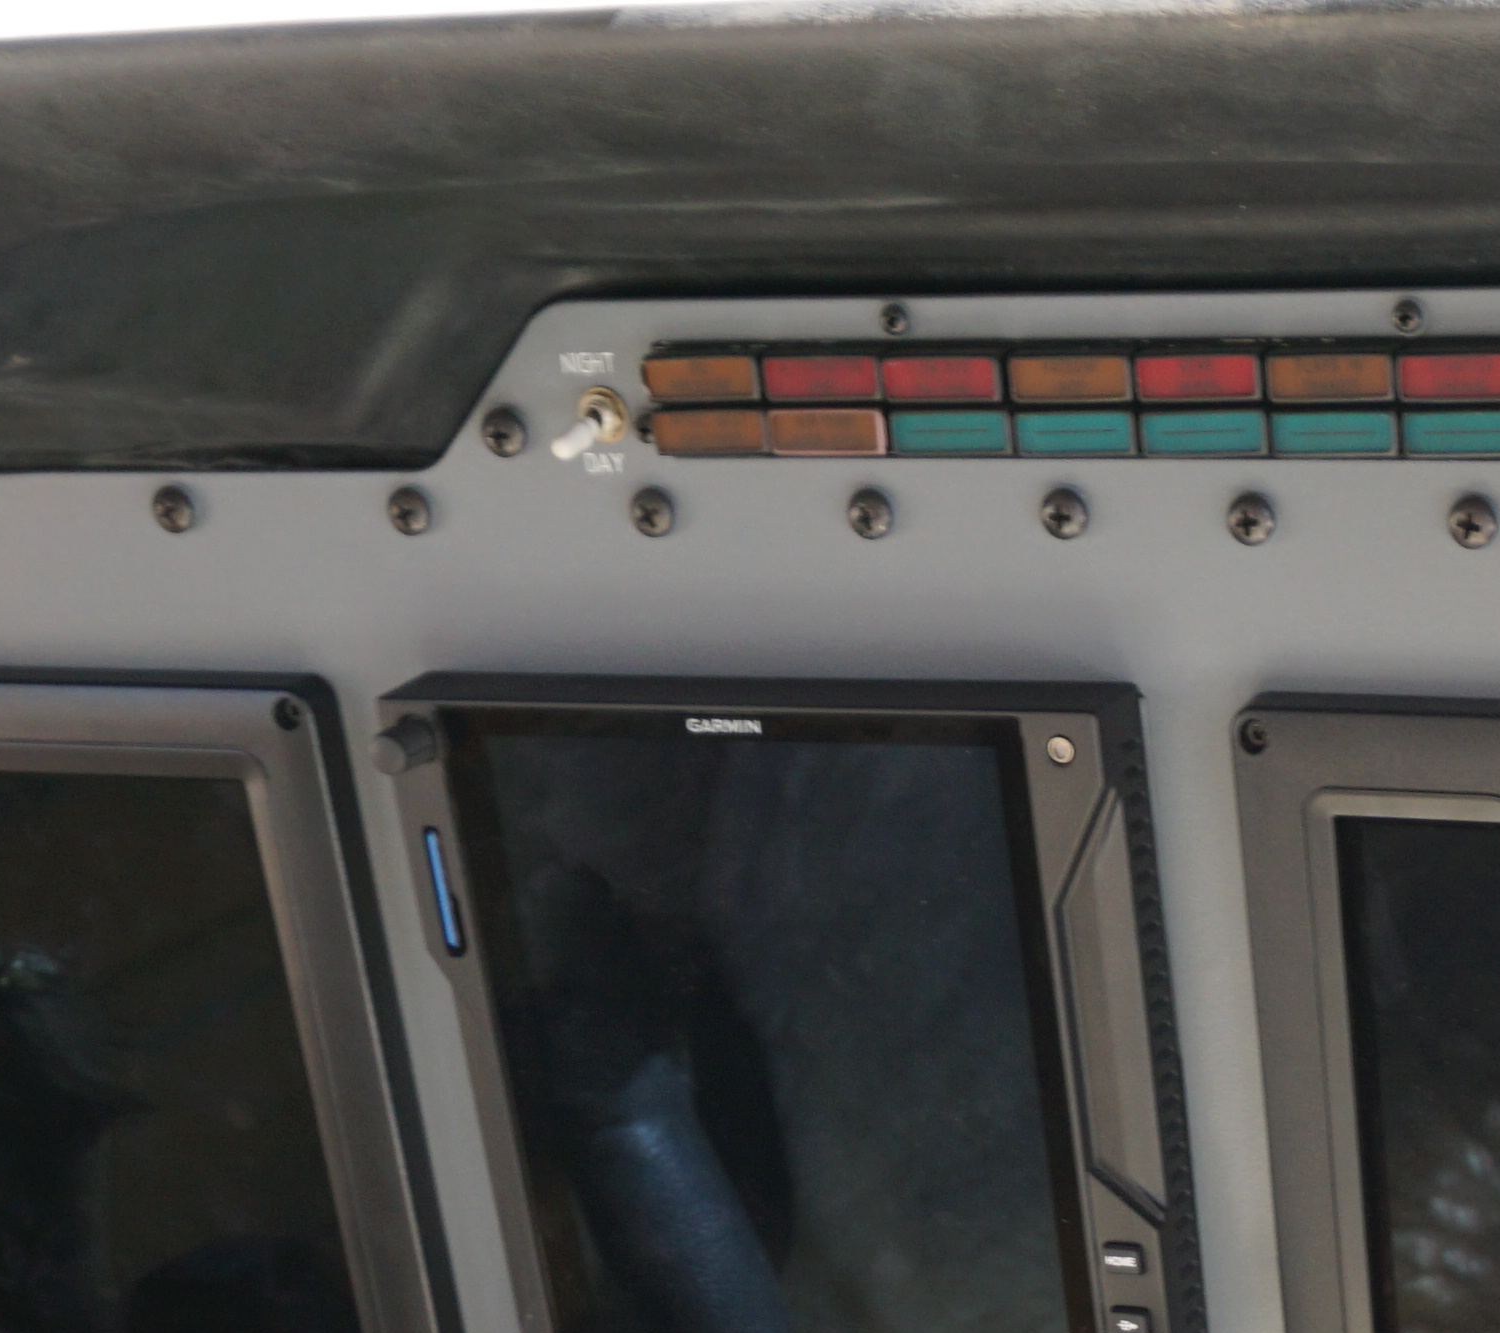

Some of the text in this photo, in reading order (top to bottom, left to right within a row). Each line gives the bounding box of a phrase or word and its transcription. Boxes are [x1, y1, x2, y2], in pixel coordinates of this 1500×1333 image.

[559, 352, 614, 374] NIGHT
[582, 452, 625, 473] DAY
[685, 718, 762, 735] GARMIN
